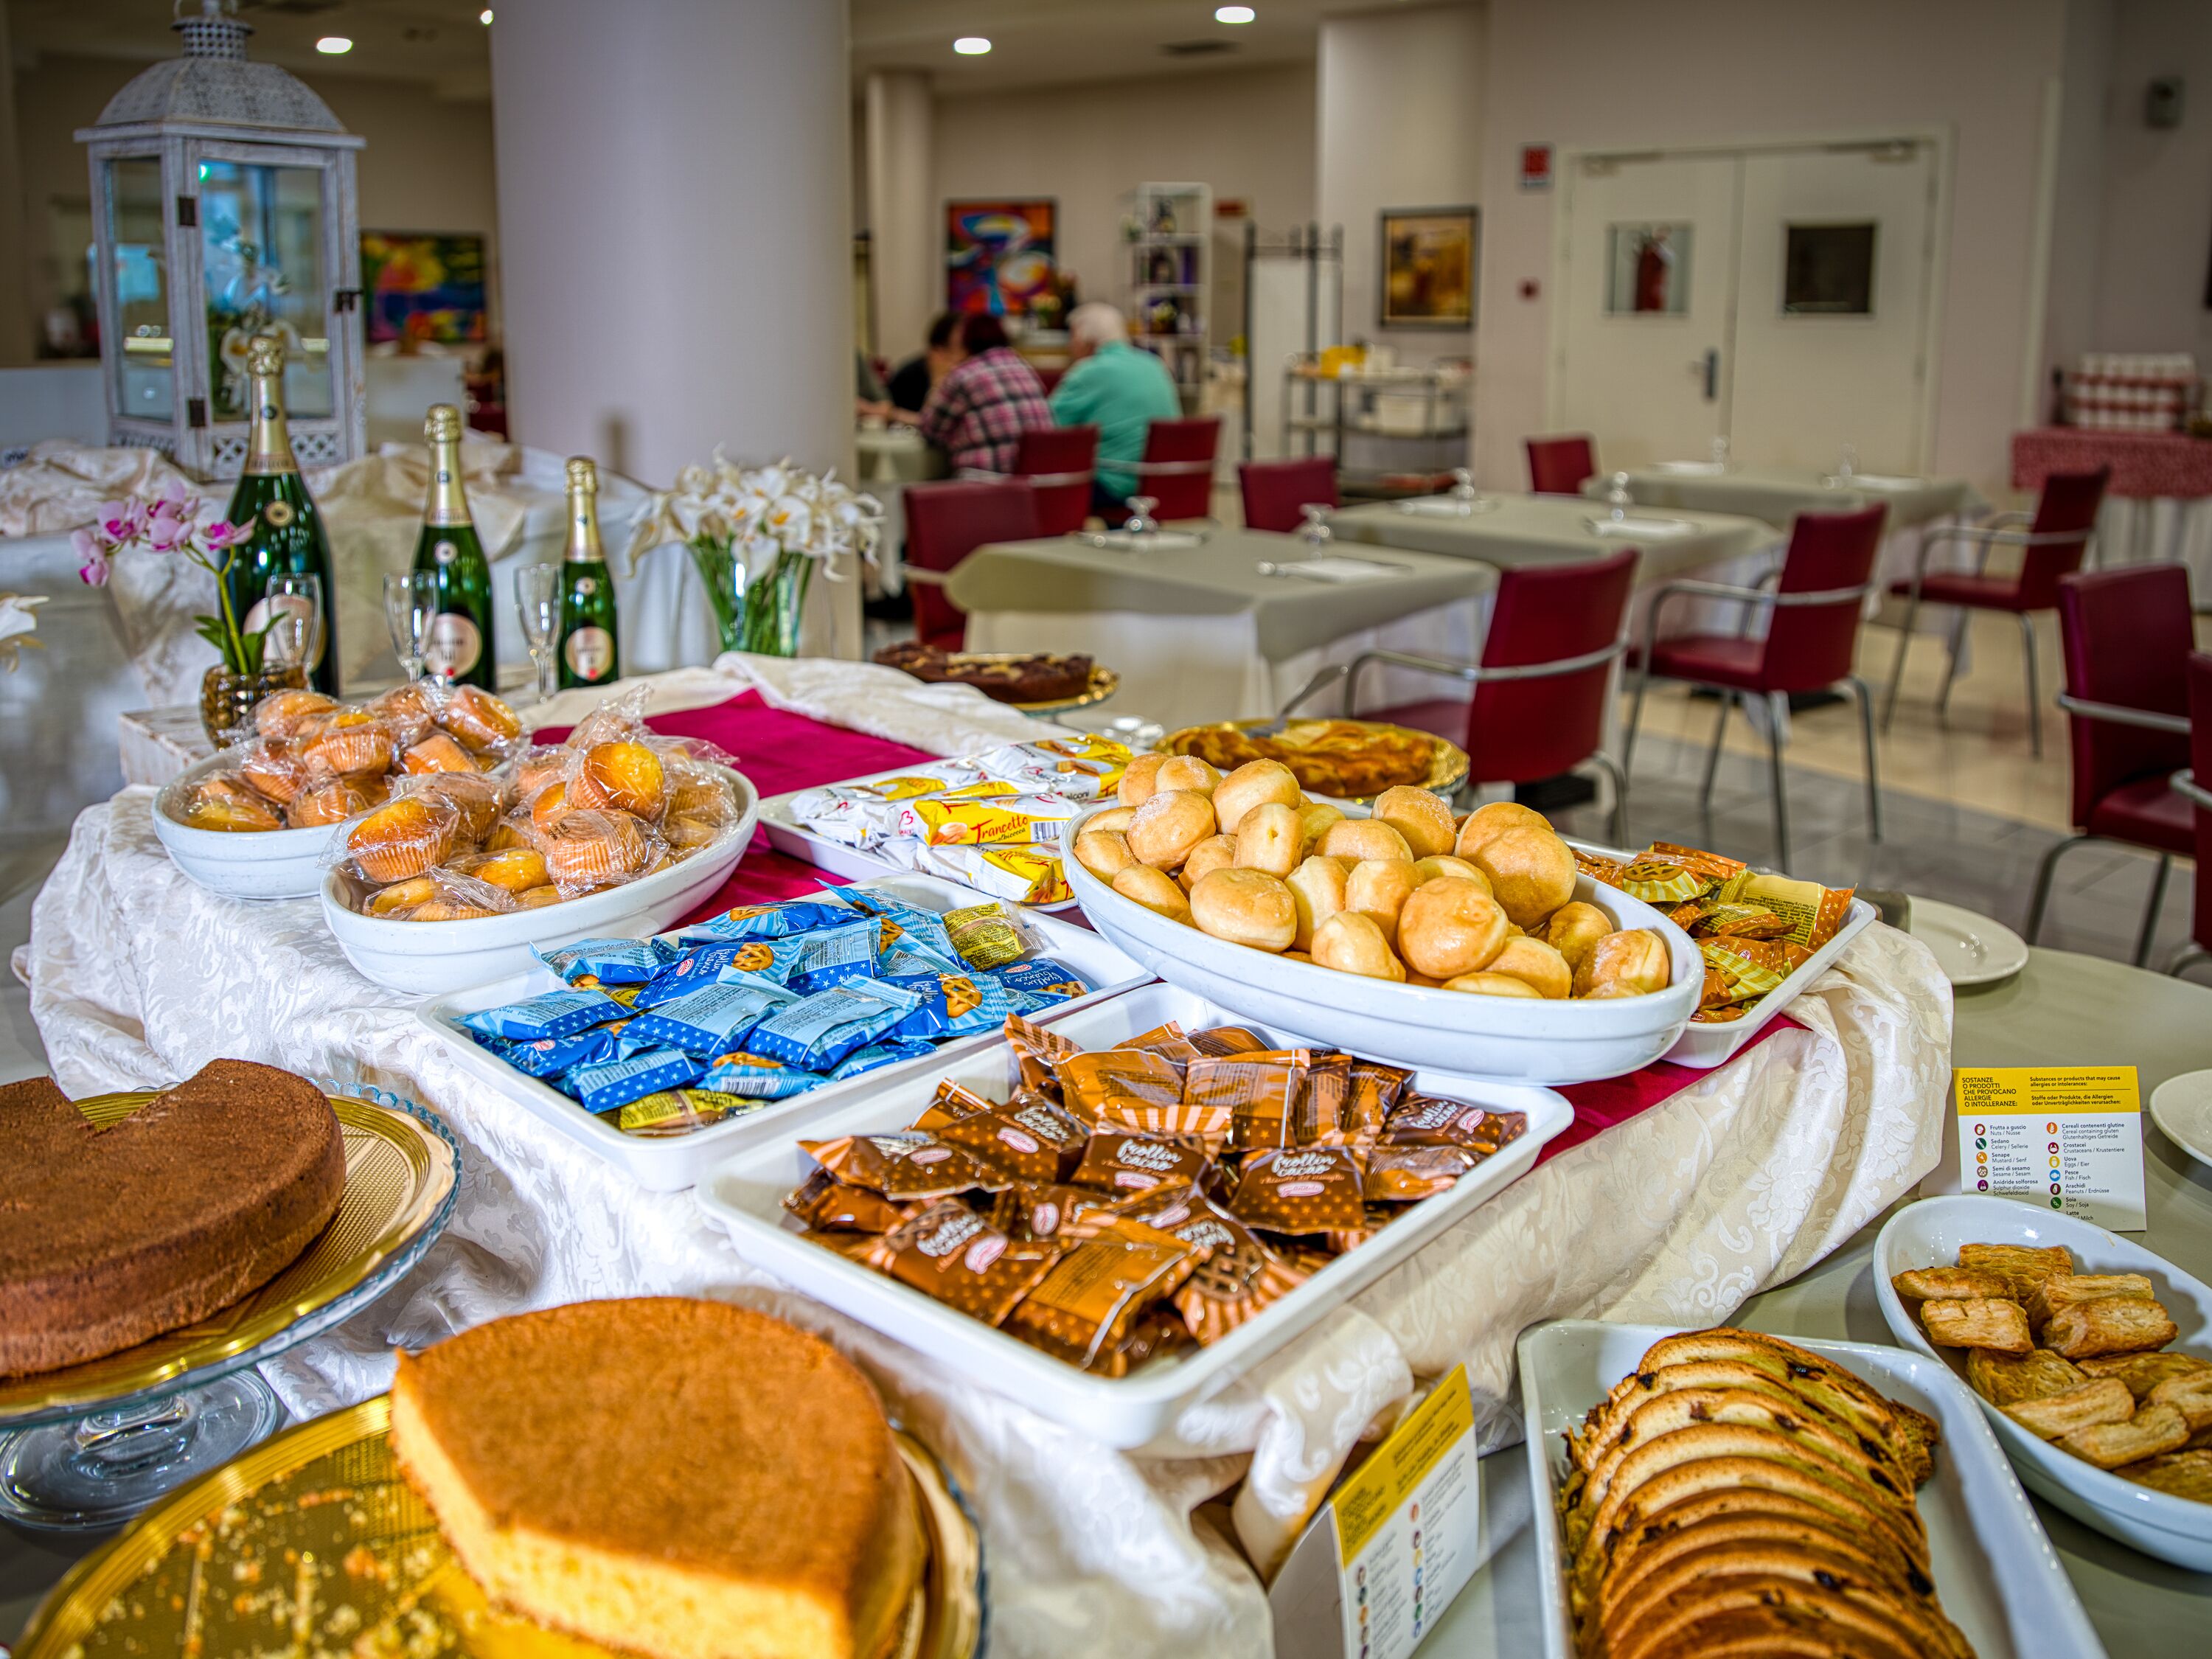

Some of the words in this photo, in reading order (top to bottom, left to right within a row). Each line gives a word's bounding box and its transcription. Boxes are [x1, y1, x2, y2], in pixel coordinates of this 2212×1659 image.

[970, 815, 1028, 844] Trancetto
[998, 828, 1026, 841] albicocca
[1271, 1152, 1337, 1173] frollin
